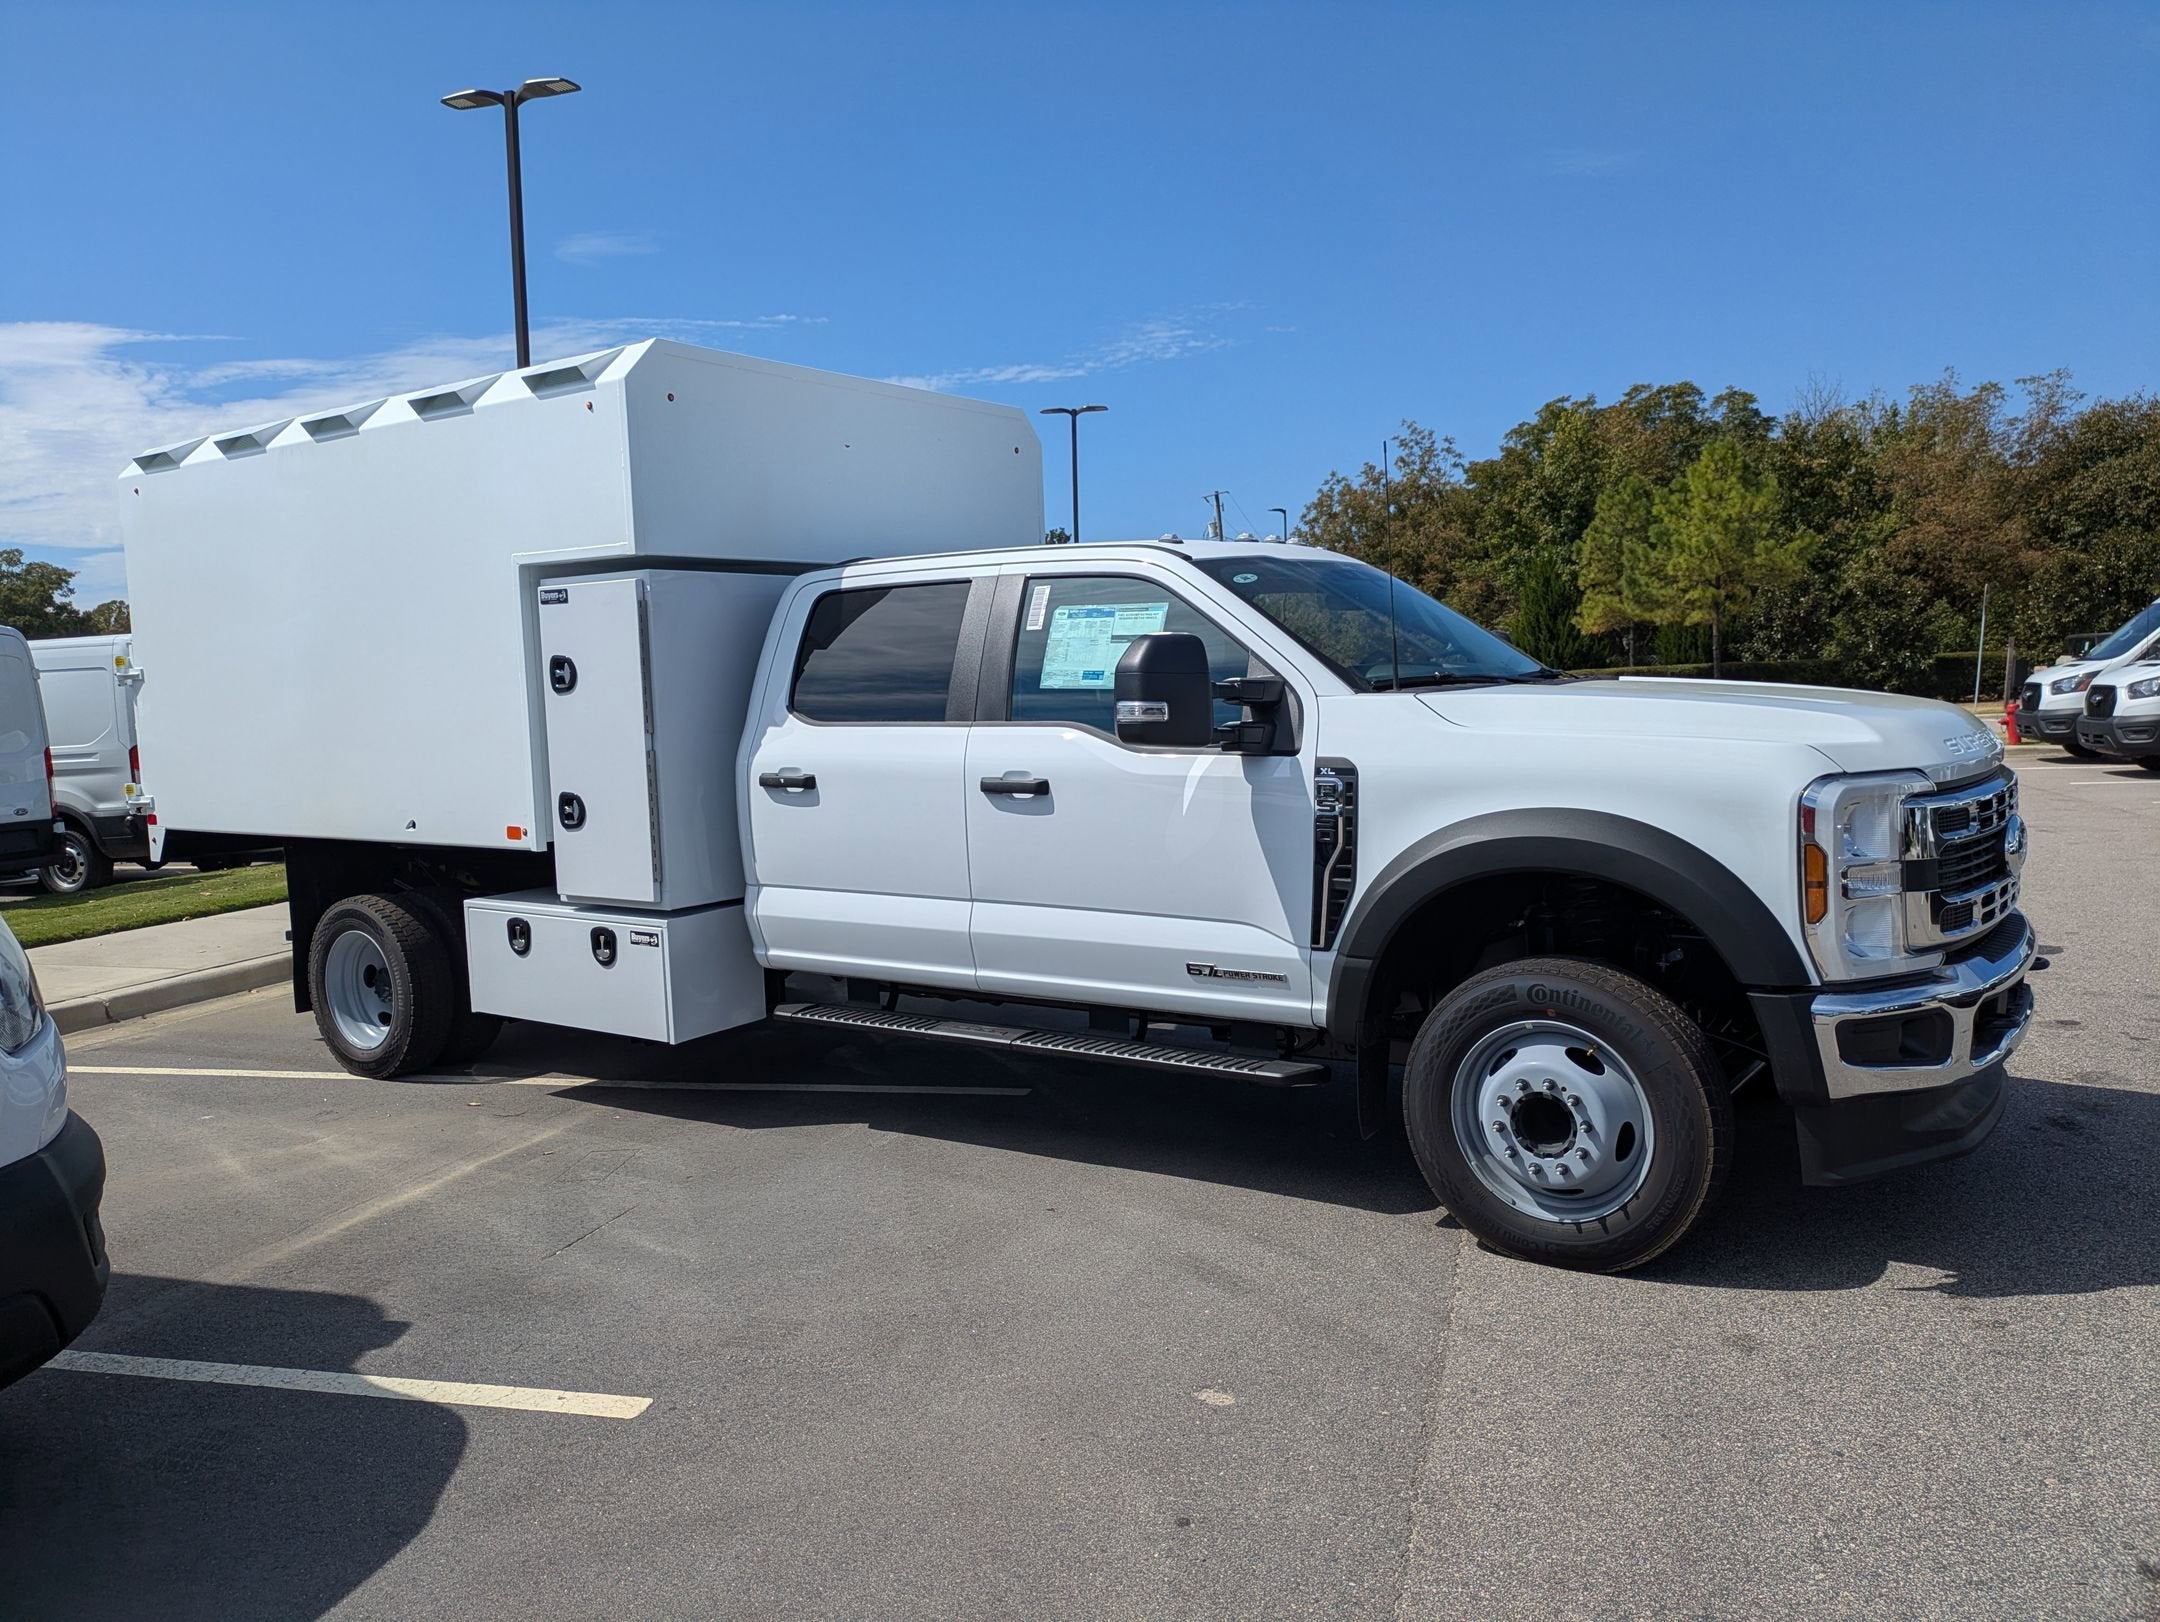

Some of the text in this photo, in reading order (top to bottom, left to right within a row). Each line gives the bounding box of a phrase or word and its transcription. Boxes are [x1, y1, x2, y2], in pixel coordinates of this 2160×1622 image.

[1319, 767, 1336, 775] XL
[1186, 961, 1223, 978] 6.7L
[1223, 969, 1251, 980] POWER
[1252, 972, 1284, 982] STROKE
[1526, 983, 1645, 1043] Continental
